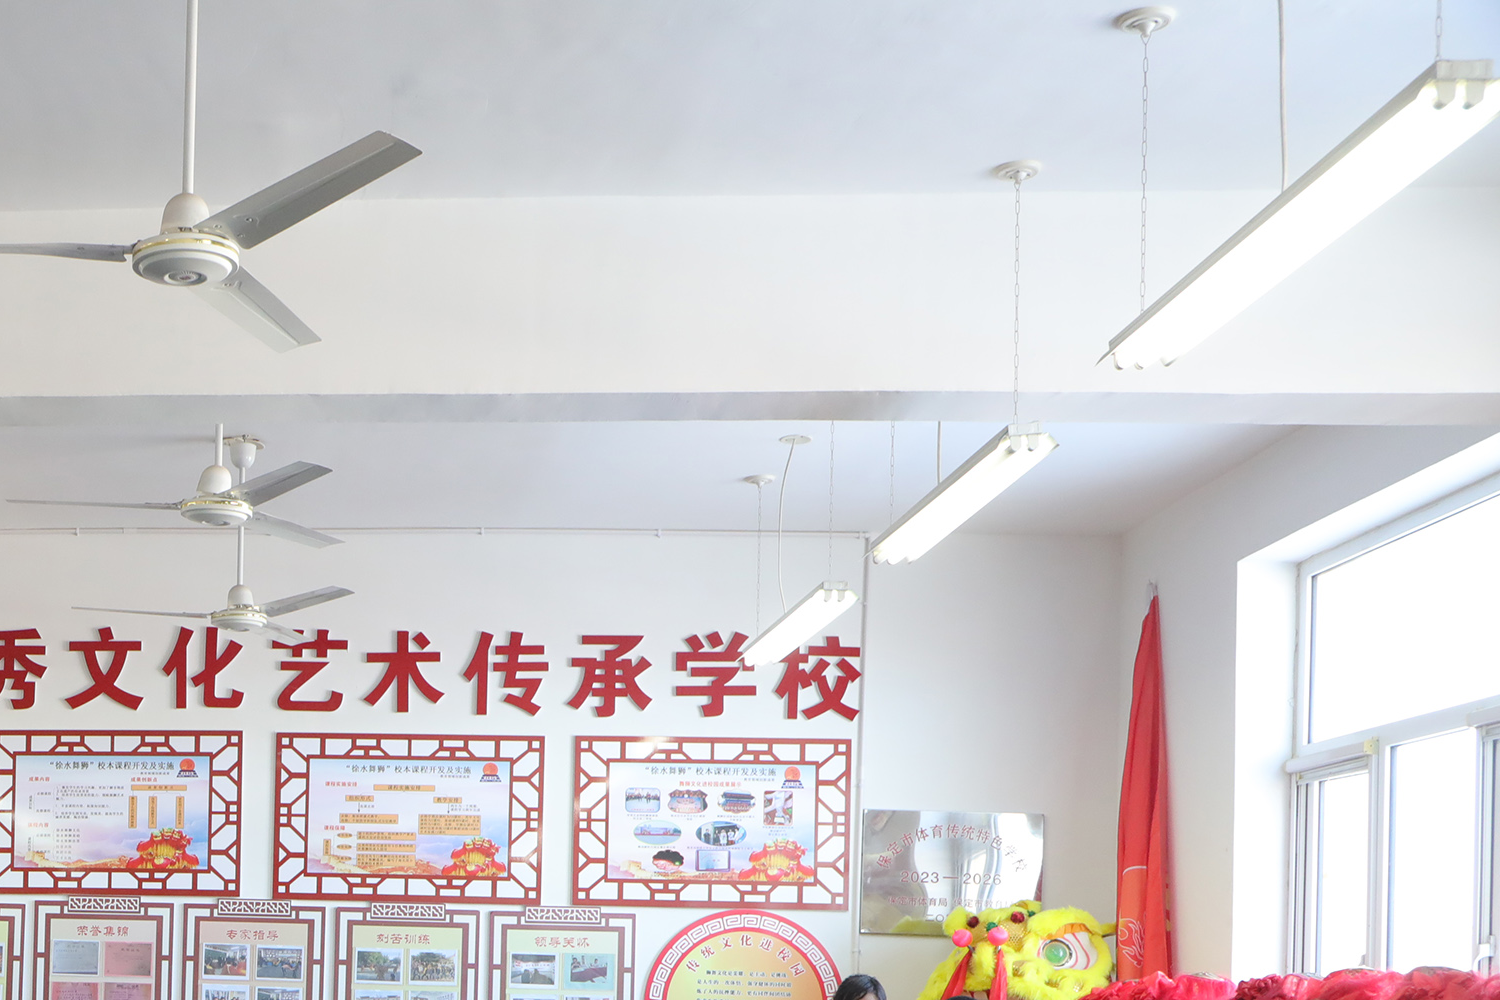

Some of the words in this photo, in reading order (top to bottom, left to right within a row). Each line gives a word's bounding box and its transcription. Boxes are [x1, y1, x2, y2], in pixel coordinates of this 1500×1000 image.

[888, 897, 948, 907] 保定市体育局
[77, 925, 129, 937] 荣誉集锦
[226, 929, 279, 941] 专家指导
[376, 933, 431, 945] 刻苦训练
[534, 937, 590, 948] 领导关怀
[686, 934, 805, 976] 传统文化进校园
